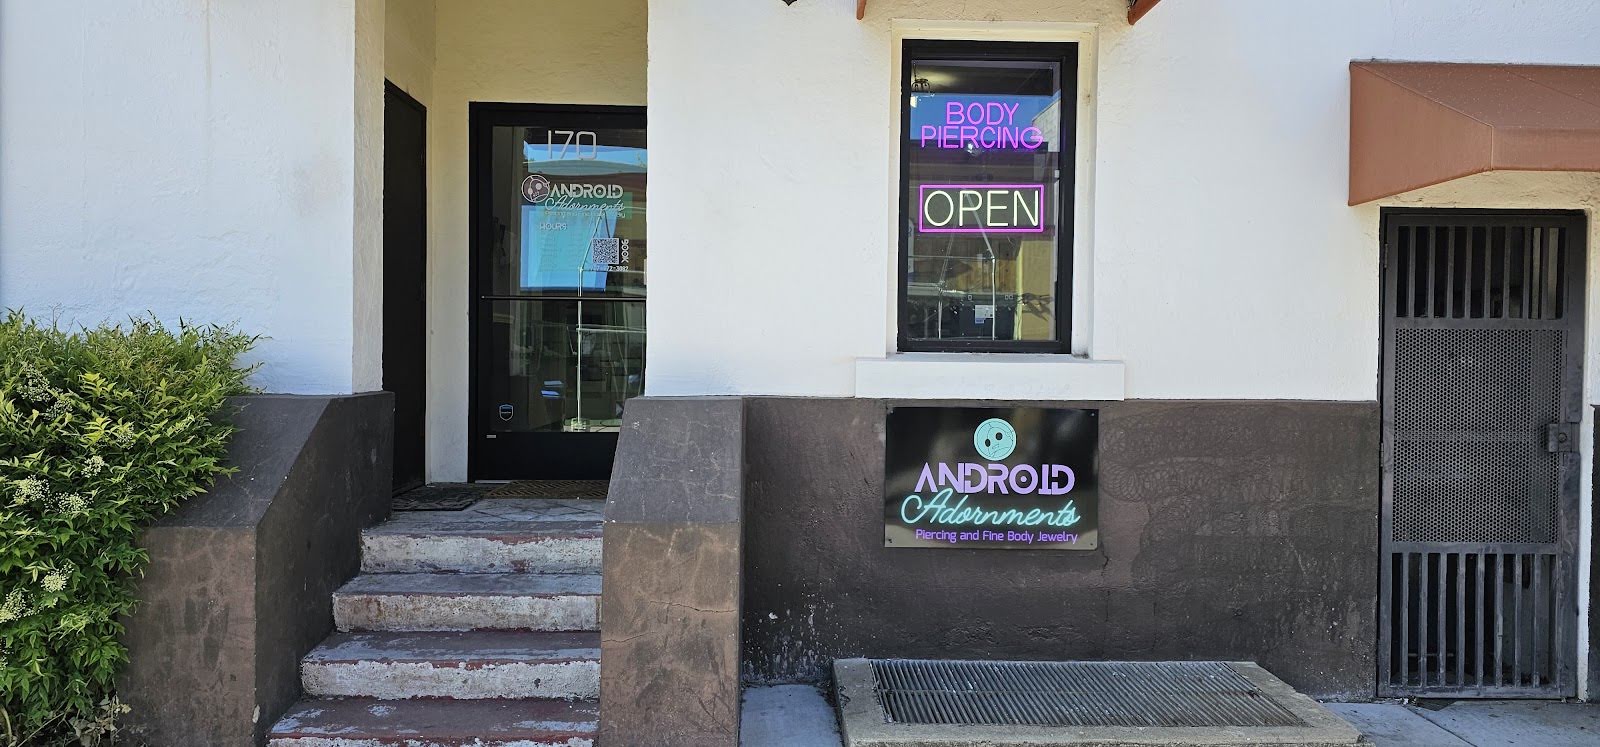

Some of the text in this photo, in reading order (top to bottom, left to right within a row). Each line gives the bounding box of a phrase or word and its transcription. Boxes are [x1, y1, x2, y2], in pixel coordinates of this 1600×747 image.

[946, 102, 1019, 126] BODY
[547, 130, 597, 160] 170
[921, 125, 1044, 149] PIERCING
[544, 195, 625, 211] Adornments
[550, 183, 623, 199] ANDROID
[924, 190, 1039, 227] OPEN
[621, 239, 629, 263] BOOK
[914, 462, 1076, 495] ANDROID
[900, 488, 1081, 527] Adornments
[915, 529, 957, 543] Piercing
[959, 530, 979, 541] and
[1007, 530, 1034, 544] Body
[1037, 531, 1078, 545] Jewelry
